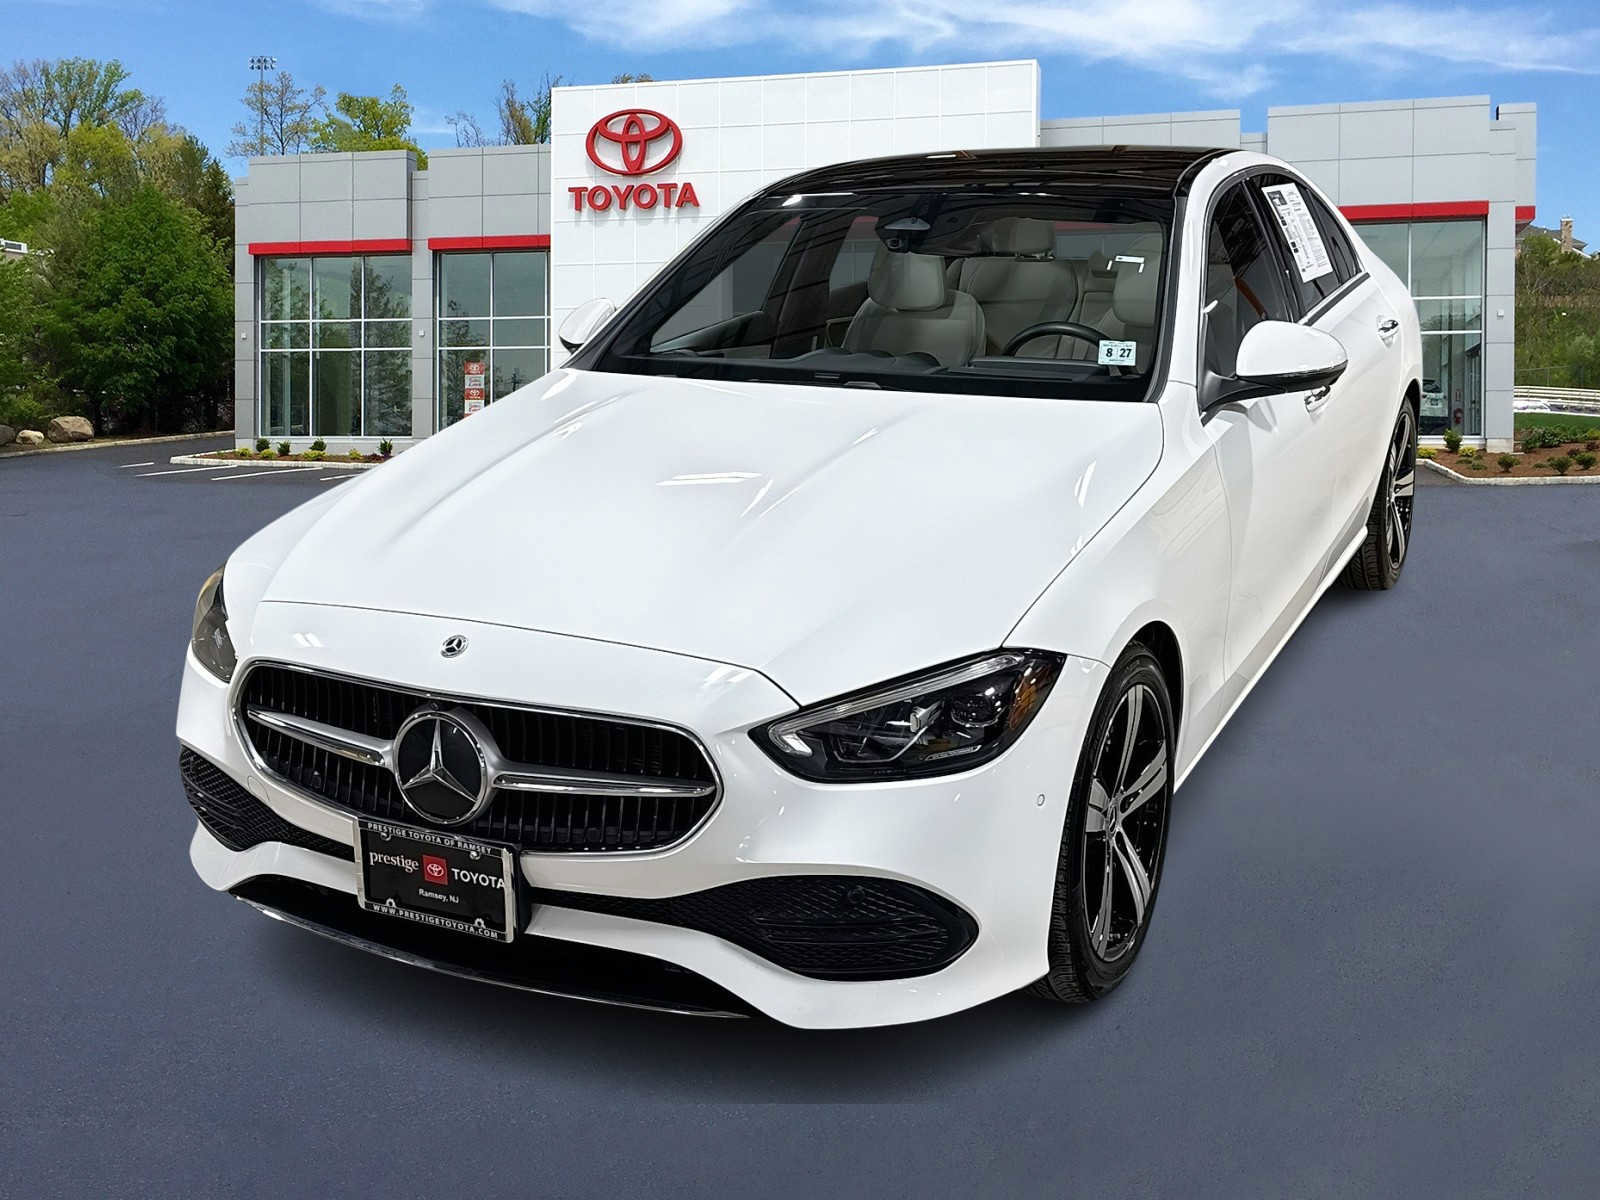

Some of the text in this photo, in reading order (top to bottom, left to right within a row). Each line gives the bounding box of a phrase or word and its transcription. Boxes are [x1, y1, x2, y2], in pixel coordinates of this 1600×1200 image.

[568, 183, 700, 212] TOYOTA
[1106, 348, 1132, 357] 8 27
[368, 822, 491, 854] PRESTIGE TOYOTA OF RAMSEY
[369, 851, 419, 872] prestige
[451, 868, 505, 889] TOYOTA
[418, 888, 459, 904] Ramsey, NJ
[373, 903, 498, 939] WWW.PRESTIGETOYOTA.COM
